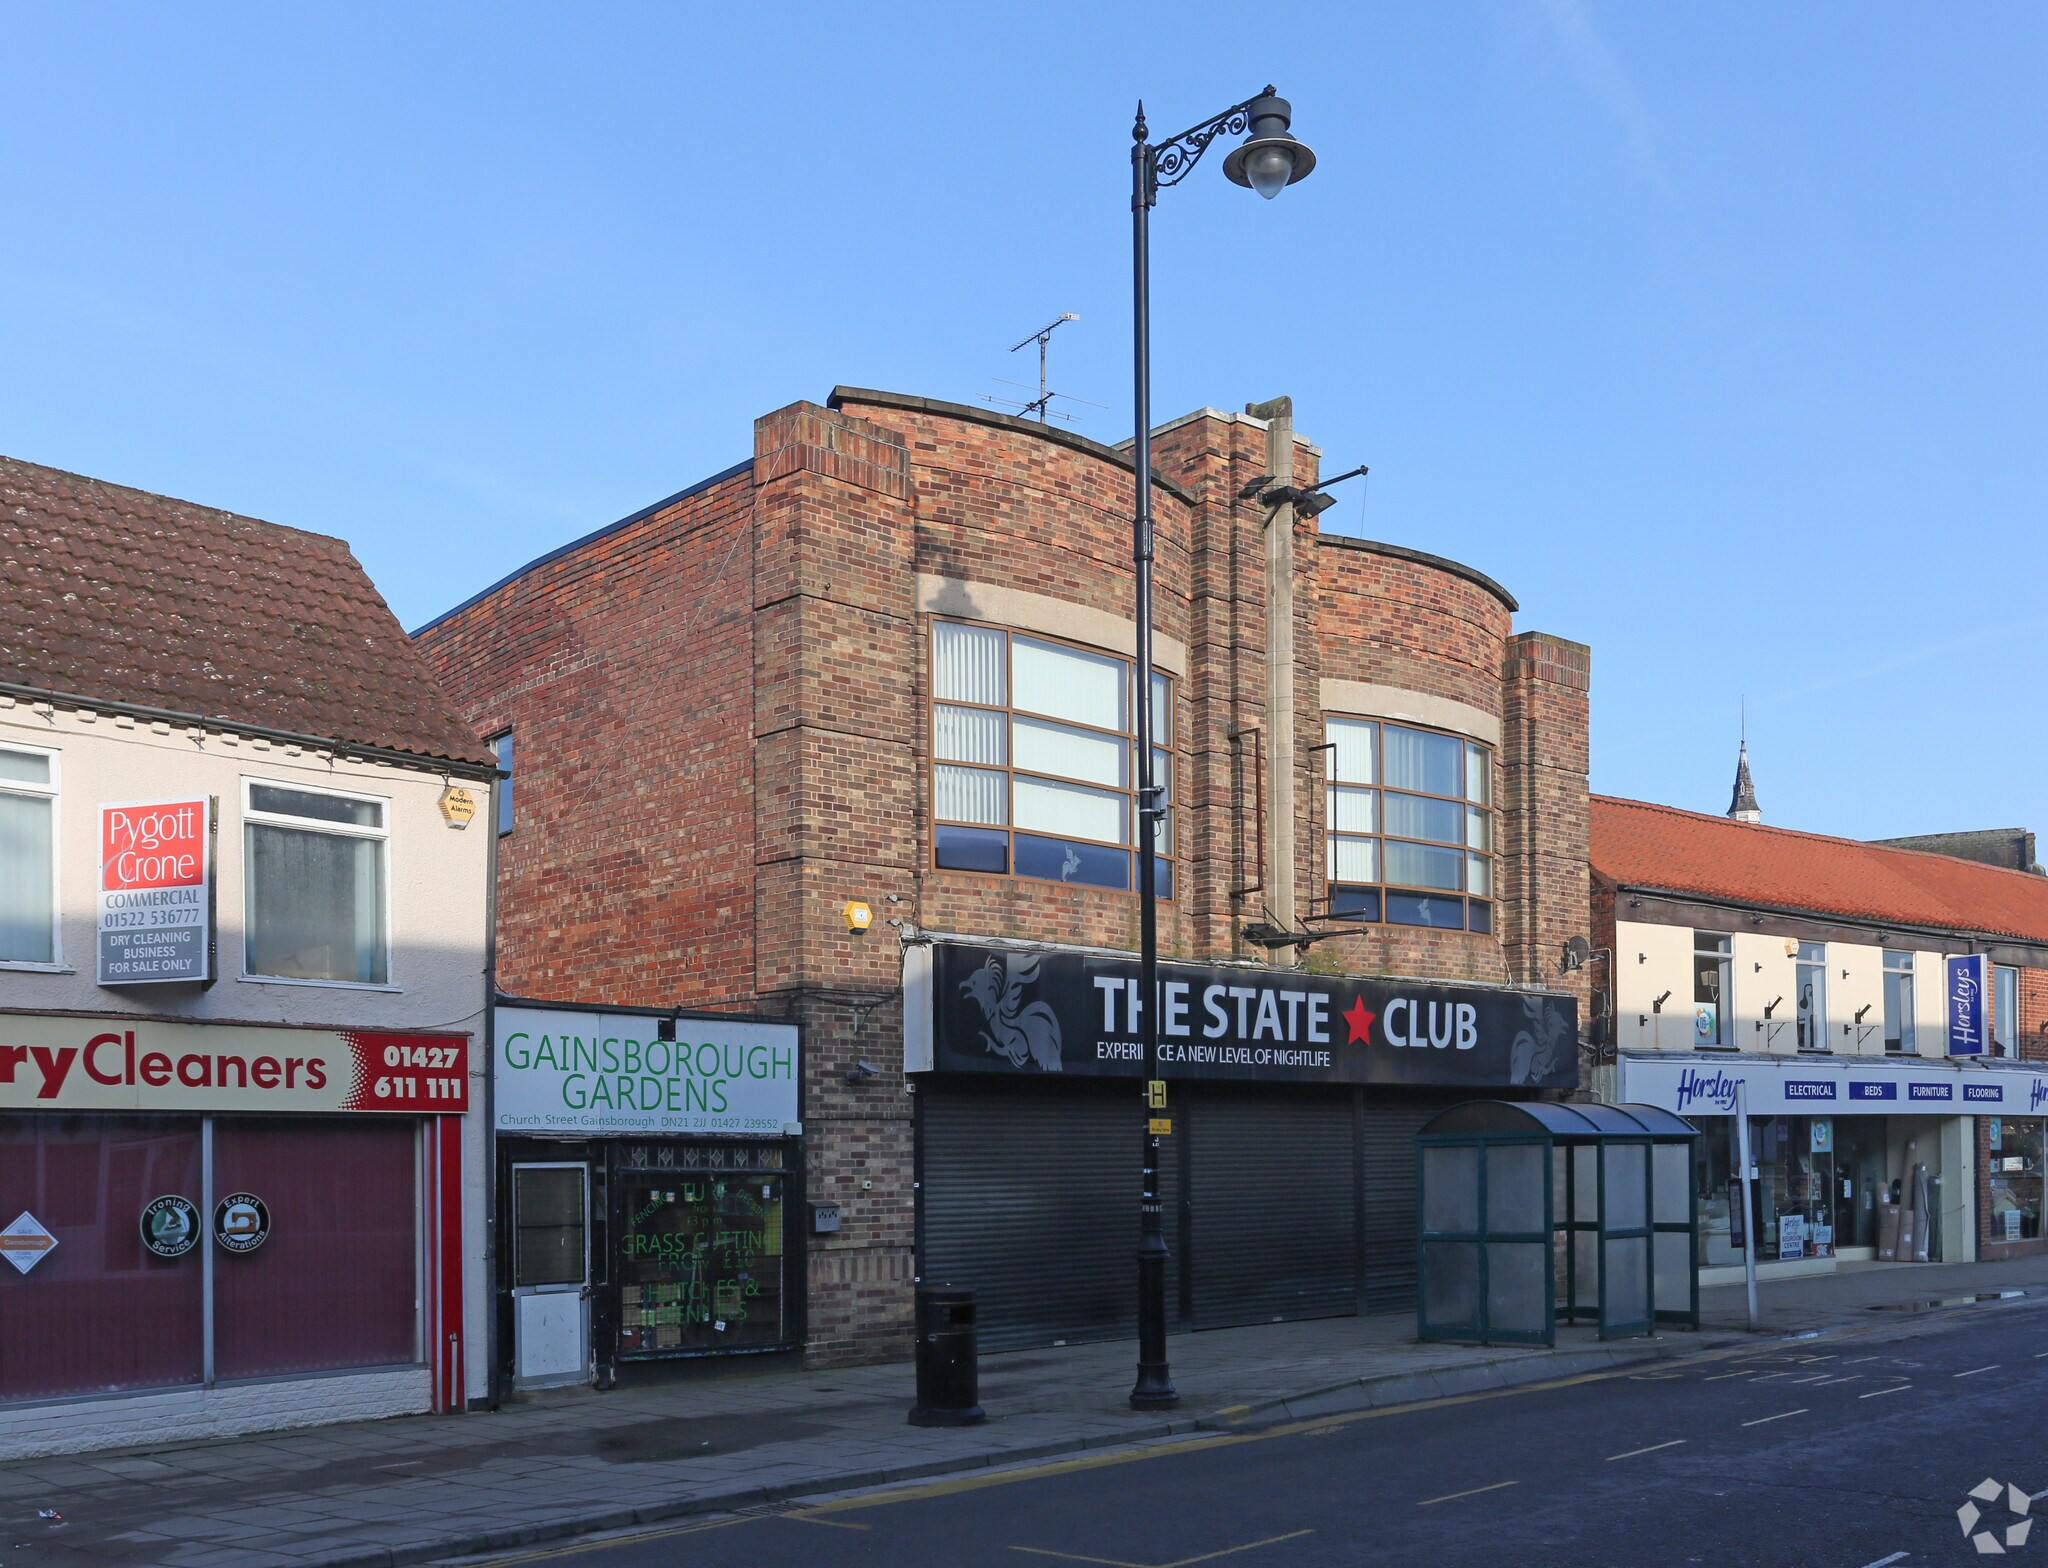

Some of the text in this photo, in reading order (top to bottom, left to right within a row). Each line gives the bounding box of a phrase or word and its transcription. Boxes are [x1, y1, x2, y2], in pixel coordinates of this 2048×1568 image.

[450, 796, 474, 805] Modern
[451, 805, 472, 814] Alarms
[111, 807, 195, 850] Pygott
[117, 851, 195, 883] Crone
[105, 889, 200, 909] COMMERCIAL
[105, 908, 200, 928] 01522 536777
[110, 931, 191, 946] DRY CLEANING
[124, 946, 176, 959] BUSINESS
[109, 958, 192, 973] FOR SALE ONLY
[1094, 976, 1478, 1050] THE STATE CLUB
[1952, 968, 1979, 1044] Horsleys
[383, 1045, 460, 1068] 01427
[504, 1032, 792, 1080] GAINSBOROUGH
[1097, 1041, 1330, 1067] EXPERICE A NEW LEVEL OF NIGHTLIFE
[374, 1076, 461, 1099] 611 111
[562, 1073, 728, 1113] GARDENS
[1152, 1083, 1164, 1106] H
[1677, 1069, 1746, 1111] Horsley
[1789, 1084, 1833, 1096] ELECTRICAL
[1864, 1085, 1883, 1097] BEDS
[1913, 1086, 1949, 1097] FURNITURE
[1968, 1087, 1999, 1098] FLOORING
[500, 1114, 541, 1126] Church
[545, 1114, 578, 1126] Street
[581, 1115, 655, 1129] Gainsborough
[661, 1117, 689, 1128] DN21
[711, 1118, 740, 1129] 01427
[744, 1119, 778, 1129] 239552
[147, 1198, 191, 1215] Ironing
[223, 1196, 260, 1209] Expert
[152, 1240, 191, 1254] Service
[219, 1230, 266, 1250] Alterations
[621, 1233, 685, 1255] GRASS
[745, 1278, 761, 1297] &
